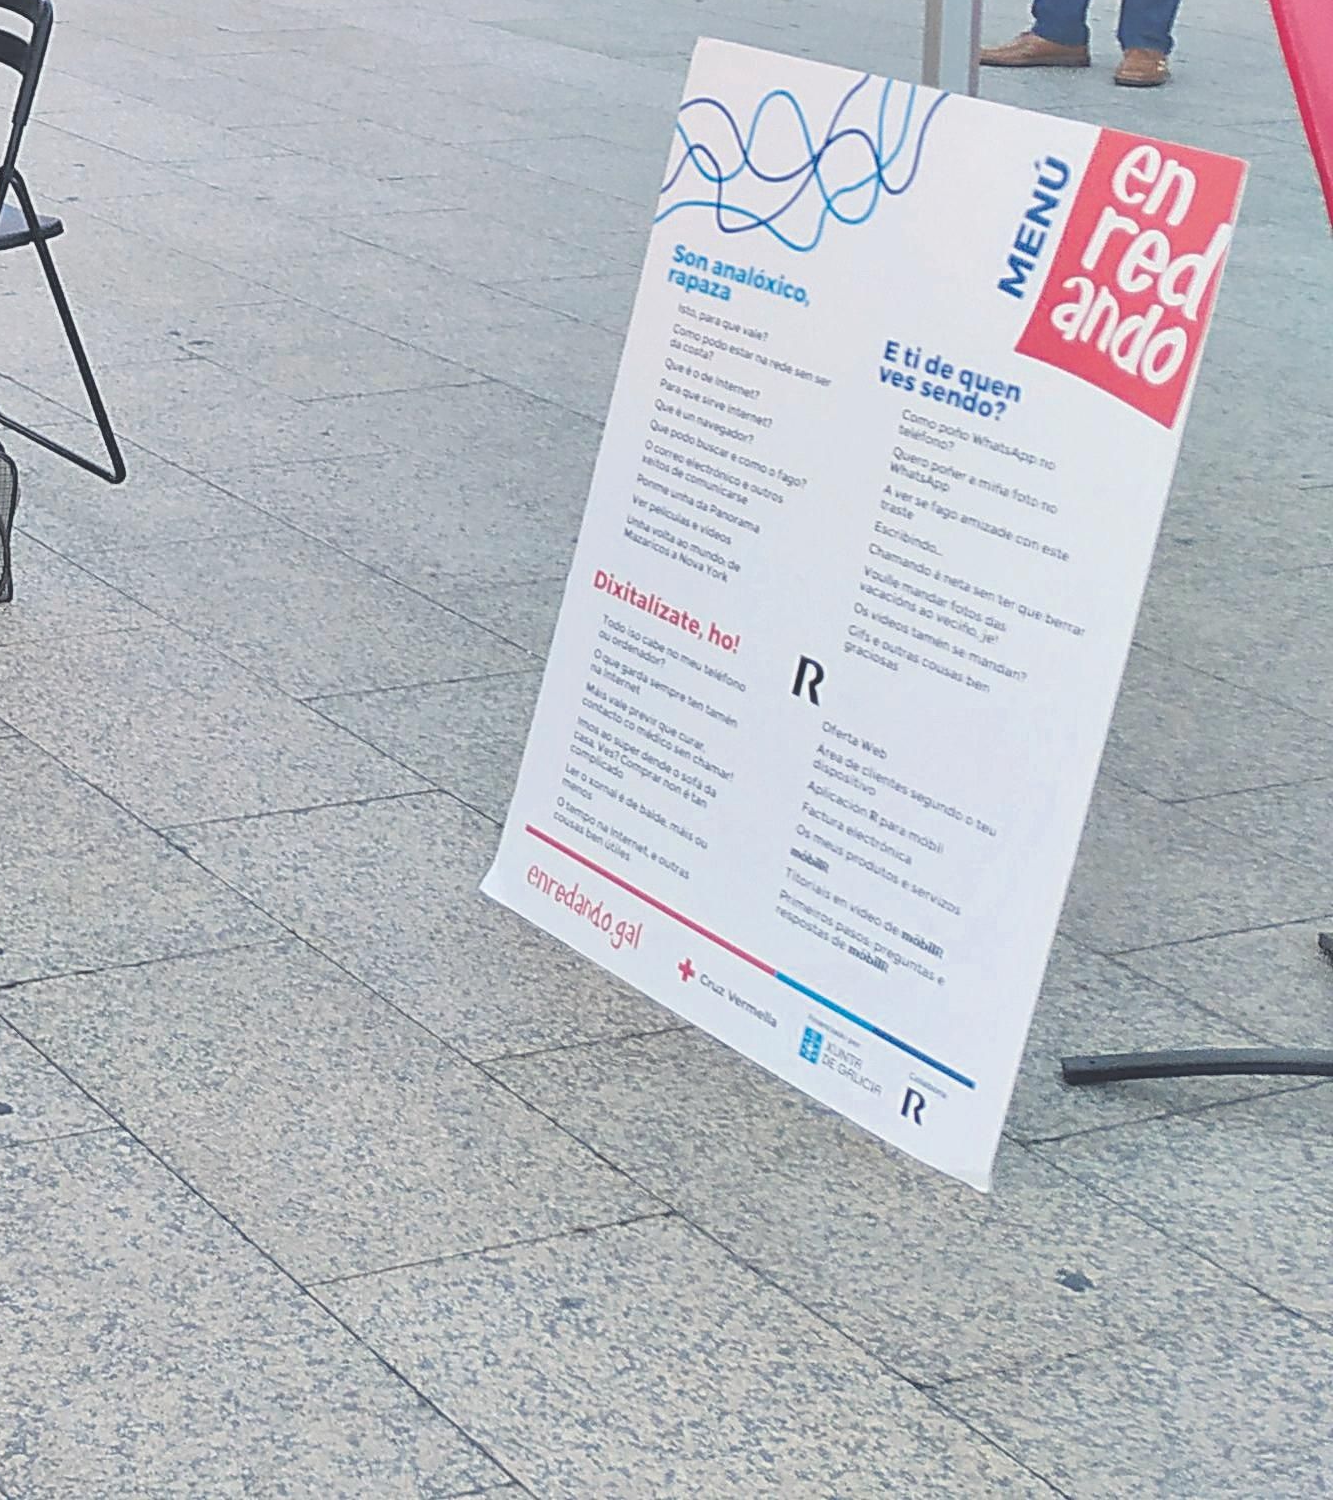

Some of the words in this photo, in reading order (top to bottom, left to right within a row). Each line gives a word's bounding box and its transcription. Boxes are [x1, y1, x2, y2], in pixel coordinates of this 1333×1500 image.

[1112, 143, 1197, 227] en
[997, 155, 1072, 300] MENÚ
[668, 268, 731, 301] rapaza
[673, 244, 708, 271] Son
[712, 261, 808, 306] analóxico,
[1081, 205, 1233, 322] red
[1050, 275, 1187, 386] ando
[880, 366, 916, 391] ves
[920, 381, 1006, 420] sendo?
[884, 340, 899, 362] E
[904, 347, 921, 369] ti
[925, 356, 954, 379] de
[959, 370, 1021, 404] quen
[594, 570, 703, 640] Dixitalízate,
[708, 623, 740, 653] ho!
[791, 654, 826, 706] R
[527, 863, 644, 949] enredando.gal
[700, 973, 727, 998] Cruz
[728, 988, 778, 1029] Vermella
[902, 1087, 928, 1126] R
